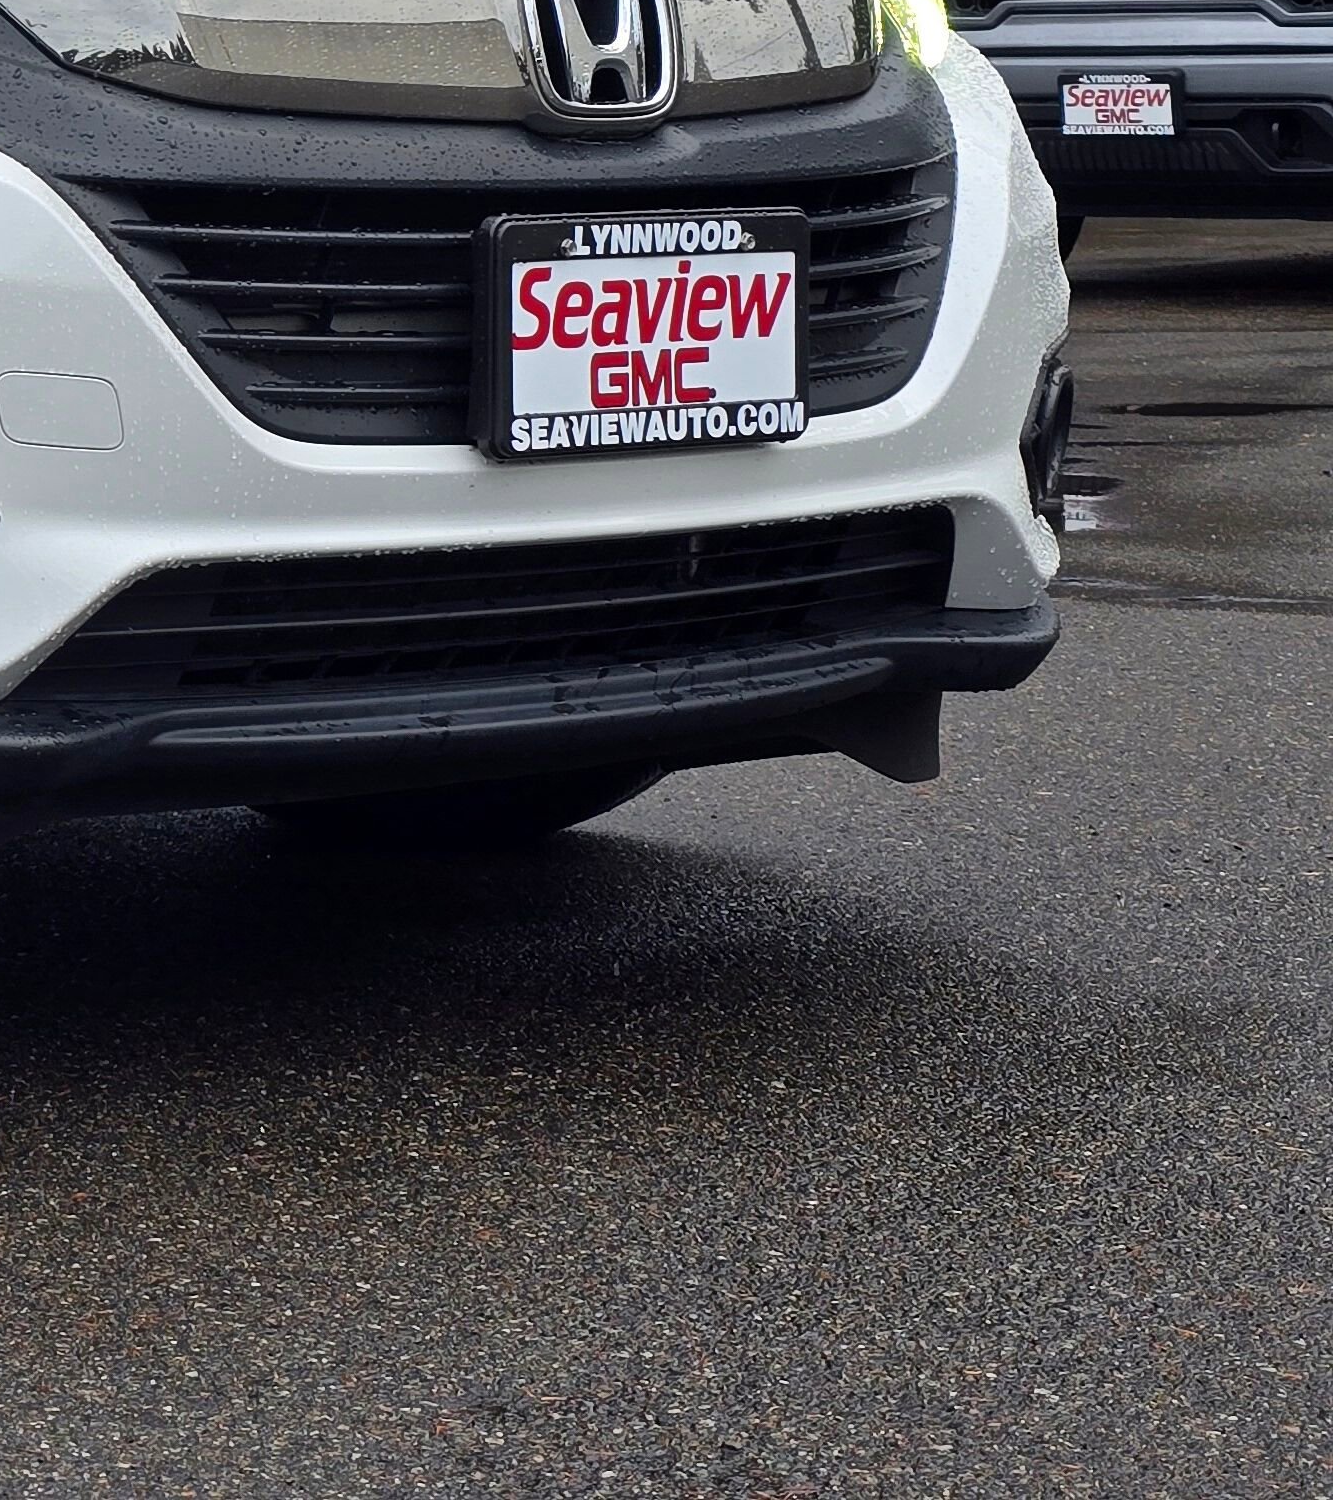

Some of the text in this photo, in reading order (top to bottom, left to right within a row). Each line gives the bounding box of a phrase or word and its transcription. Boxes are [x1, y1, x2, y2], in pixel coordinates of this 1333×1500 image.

[1066, 84, 1170, 107] Seaview
[1062, 124, 1175, 135] SEAVIEWAUTO.COM
[1095, 108, 1143, 124] GMC
[573, 220, 742, 256] LYNNWOOD
[512, 260, 791, 351] Seaview
[590, 346, 712, 409] GMC
[511, 401, 804, 452] SEAVIEWAUTO.COM
